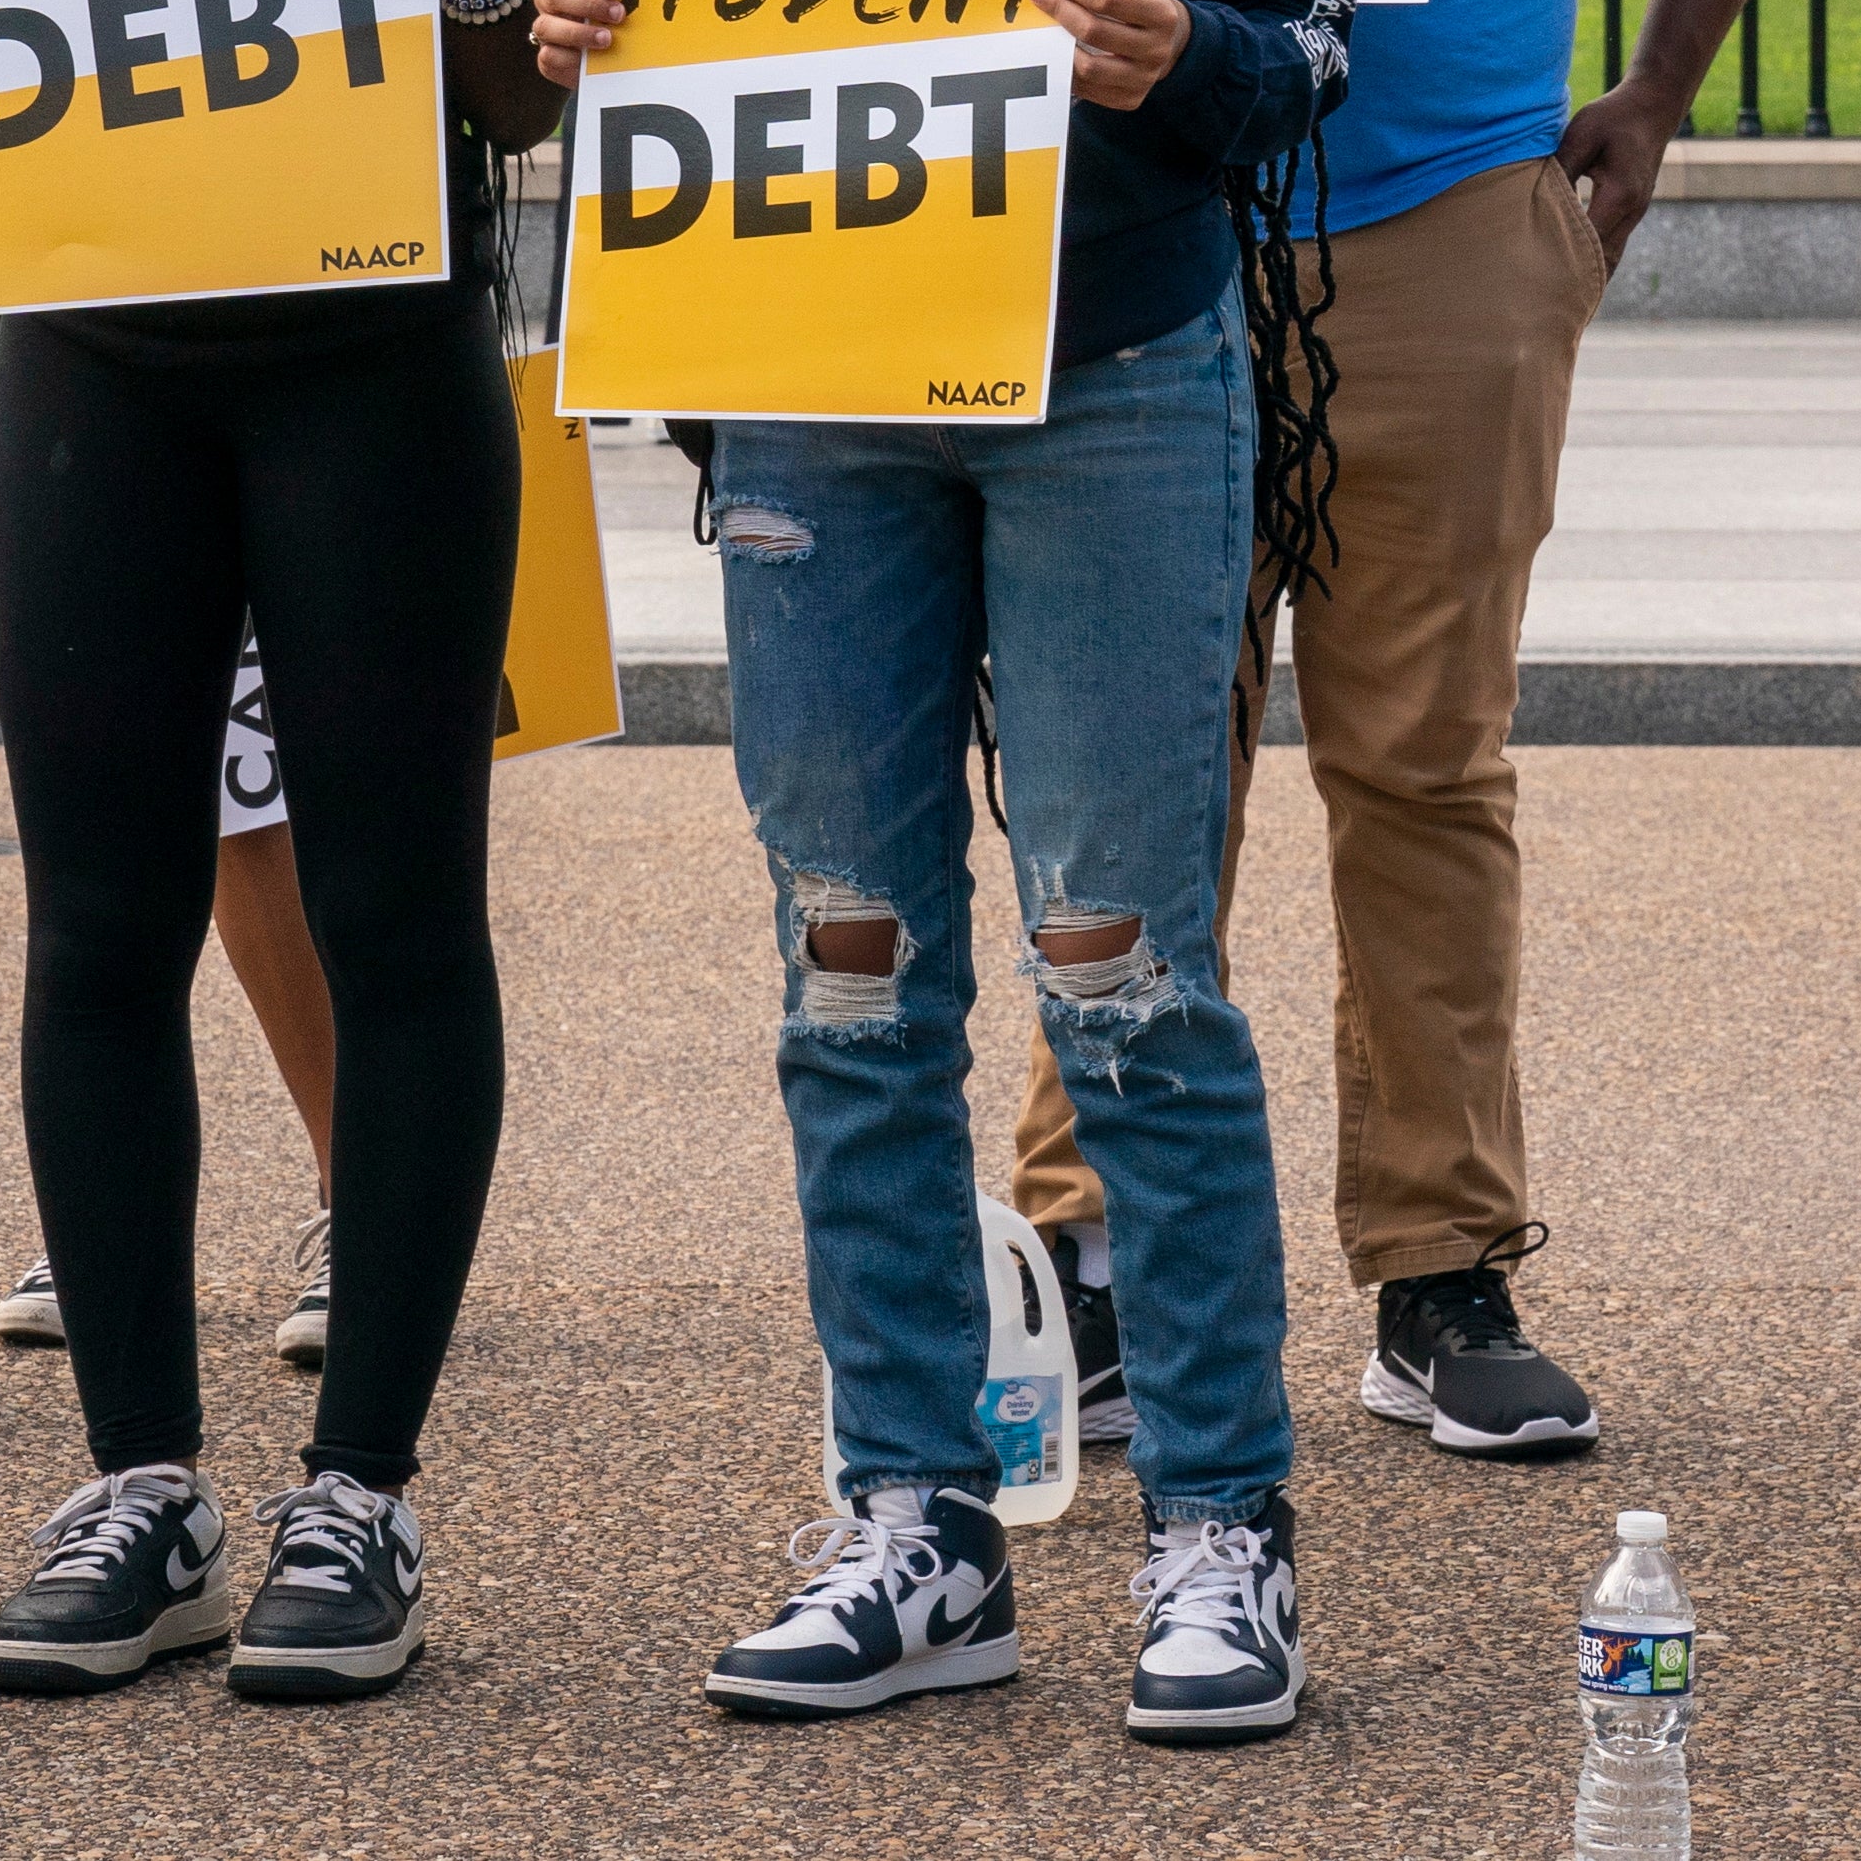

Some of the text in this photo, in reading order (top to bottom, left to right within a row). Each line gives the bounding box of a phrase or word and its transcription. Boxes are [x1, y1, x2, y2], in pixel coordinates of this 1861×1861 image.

[599, 65, 1048, 252] DEBT
[320, 241, 426, 273] NAACP
[926, 380, 1028, 407] NAACP
